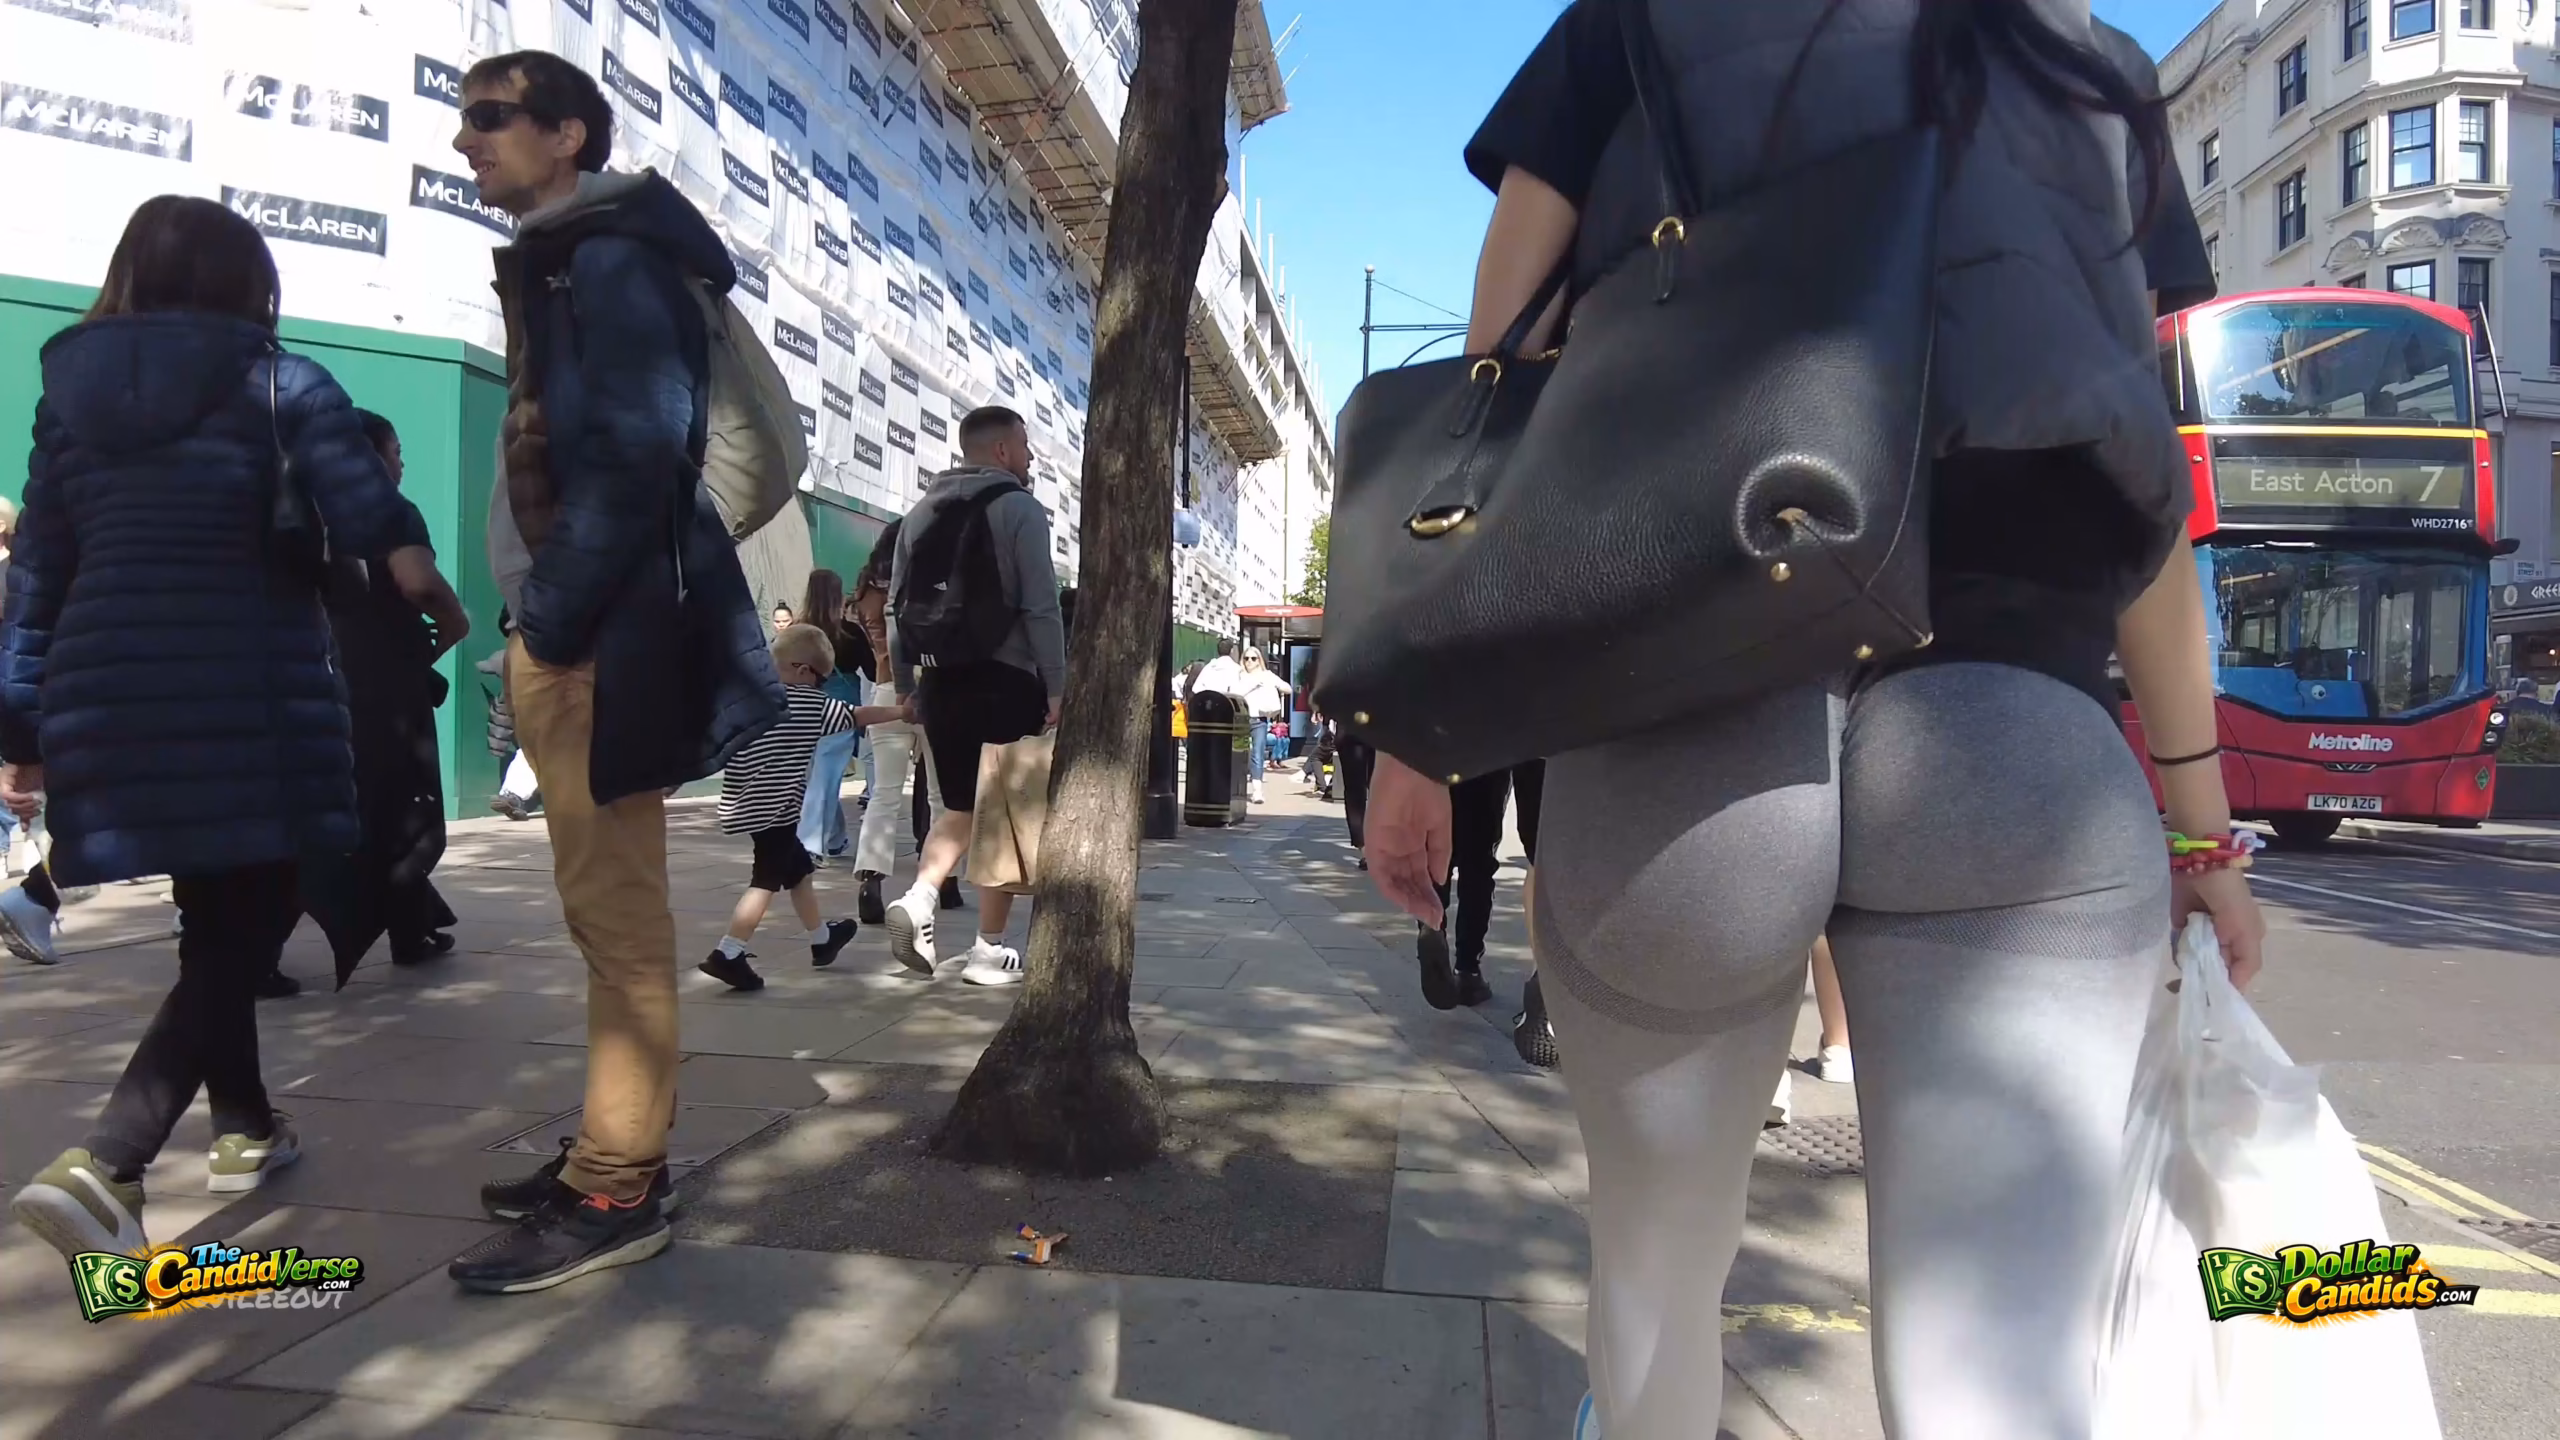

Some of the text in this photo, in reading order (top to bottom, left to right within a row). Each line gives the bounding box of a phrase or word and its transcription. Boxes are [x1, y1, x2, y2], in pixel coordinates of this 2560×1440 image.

[624, 0, 657, 27] AREN
[668, 0, 712, 41] cLAREN
[816, 3, 846, 37] McLARE
[607, 59, 658, 114] McLAREN
[671, 70, 713, 119] McLAREN
[720, 79, 763, 126] McLAREN
[4, 95, 183, 150] McLAREN
[725, 158, 767, 199] McLAREN
[231, 198, 377, 243] McLAREN
[418, 177, 513, 230] McLAREN
[733, 260, 767, 294] cLAREN
[777, 326, 816, 358] McLAREN
[822, 317, 854, 348] McLAREN
[855, 440, 881, 463] McLAREN
[2251, 466, 2446, 502] East Acton 7
[2411, 518, 2468, 530] WHD2716
[2531, 583, 2560, 600] GREE
[2308, 731, 2394, 752] Metroline
[2313, 796, 2377, 810] LK70 AZG
